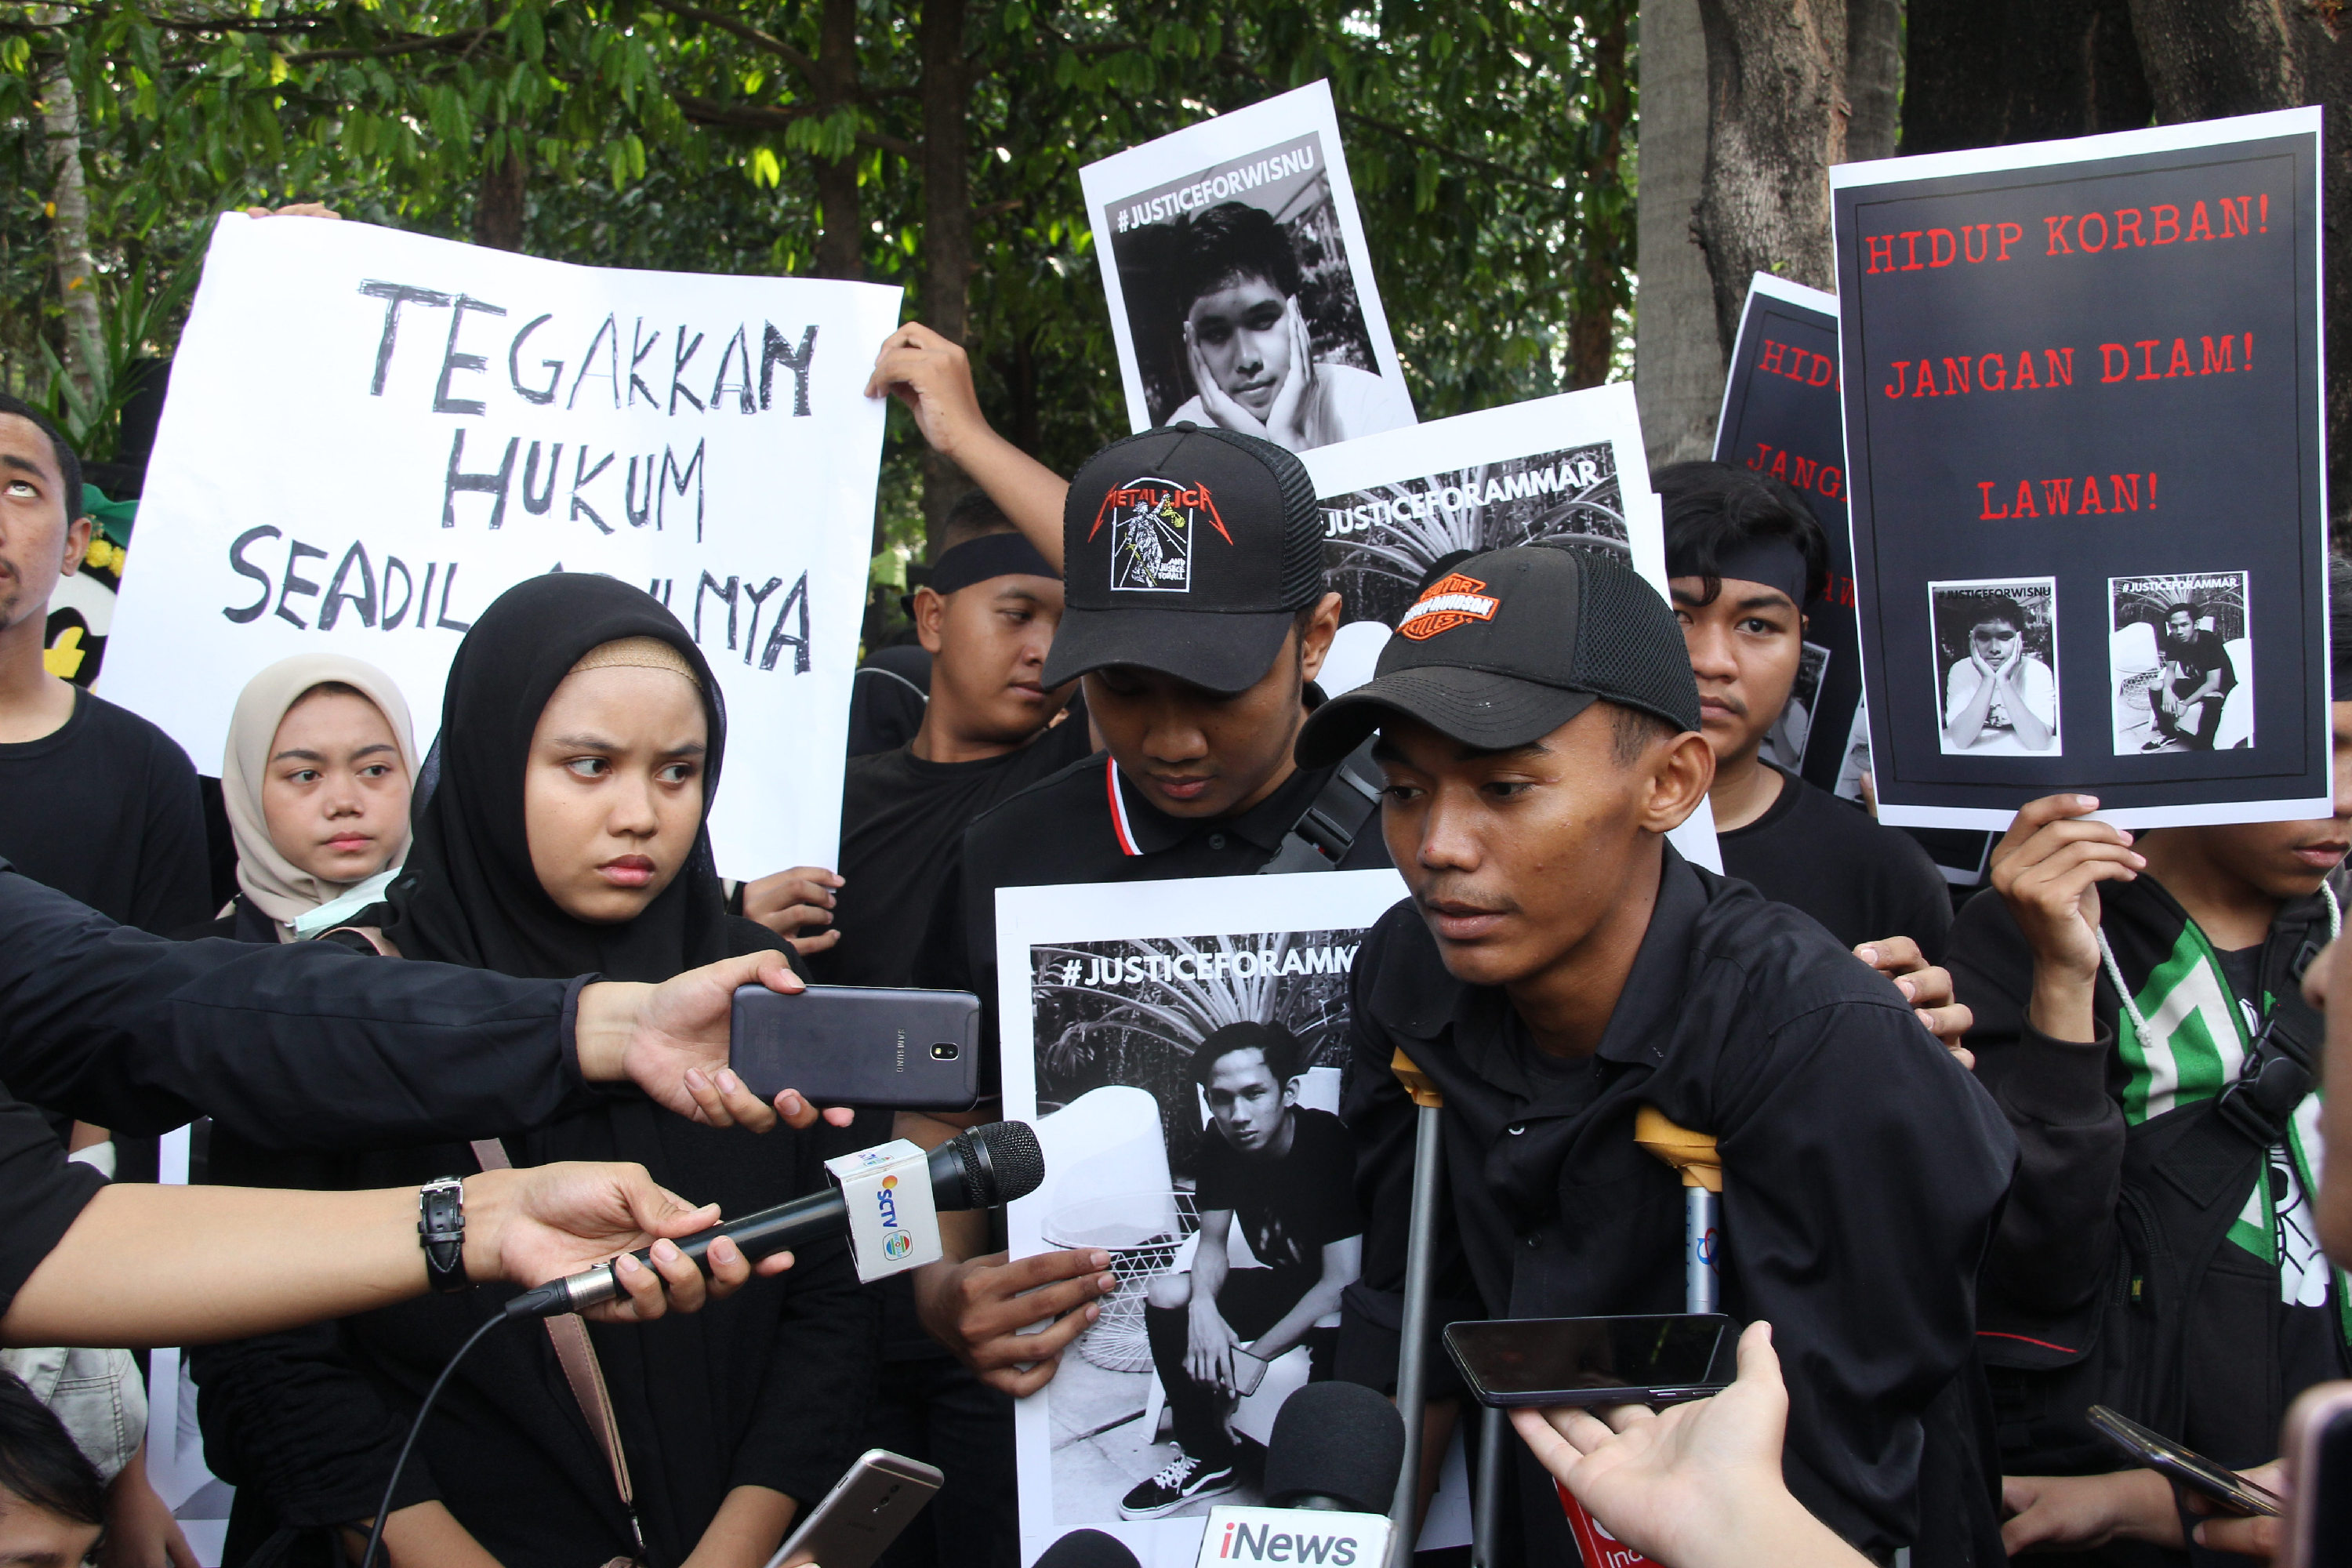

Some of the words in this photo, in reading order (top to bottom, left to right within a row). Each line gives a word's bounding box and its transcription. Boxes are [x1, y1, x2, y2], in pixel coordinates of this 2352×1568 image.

[1117, 145, 1315, 233] #JUSTICEFORWISNU
[1866, 222, 2023, 274] HIDUP
[2043, 194, 2269, 257] KORBAN!
[356, 278, 820, 417] TEGAKKAN
[1758, 339, 1841, 393] HID
[1884, 347, 2075, 399] JANGAN
[2099, 332, 2254, 383] DIAM!
[441, 427, 705, 543] HUKUM
[1319, 459, 1602, 538] JUSTICEFORAMMAR
[1746, 442, 1848, 503] JANG
[1977, 472, 2158, 521] LAWAN!
[222, 524, 470, 632] SEADIL
[1938, 586, 2053, 600] #JUSTICEFORWISNU
[2122, 577, 2241, 593] #JUSTICEFORAMMAR
[896, 1029, 906, 1073] SAMSUNG
[877, 1189, 898, 1227] SCTV
[1220, 1522, 1358, 1566] iNews
